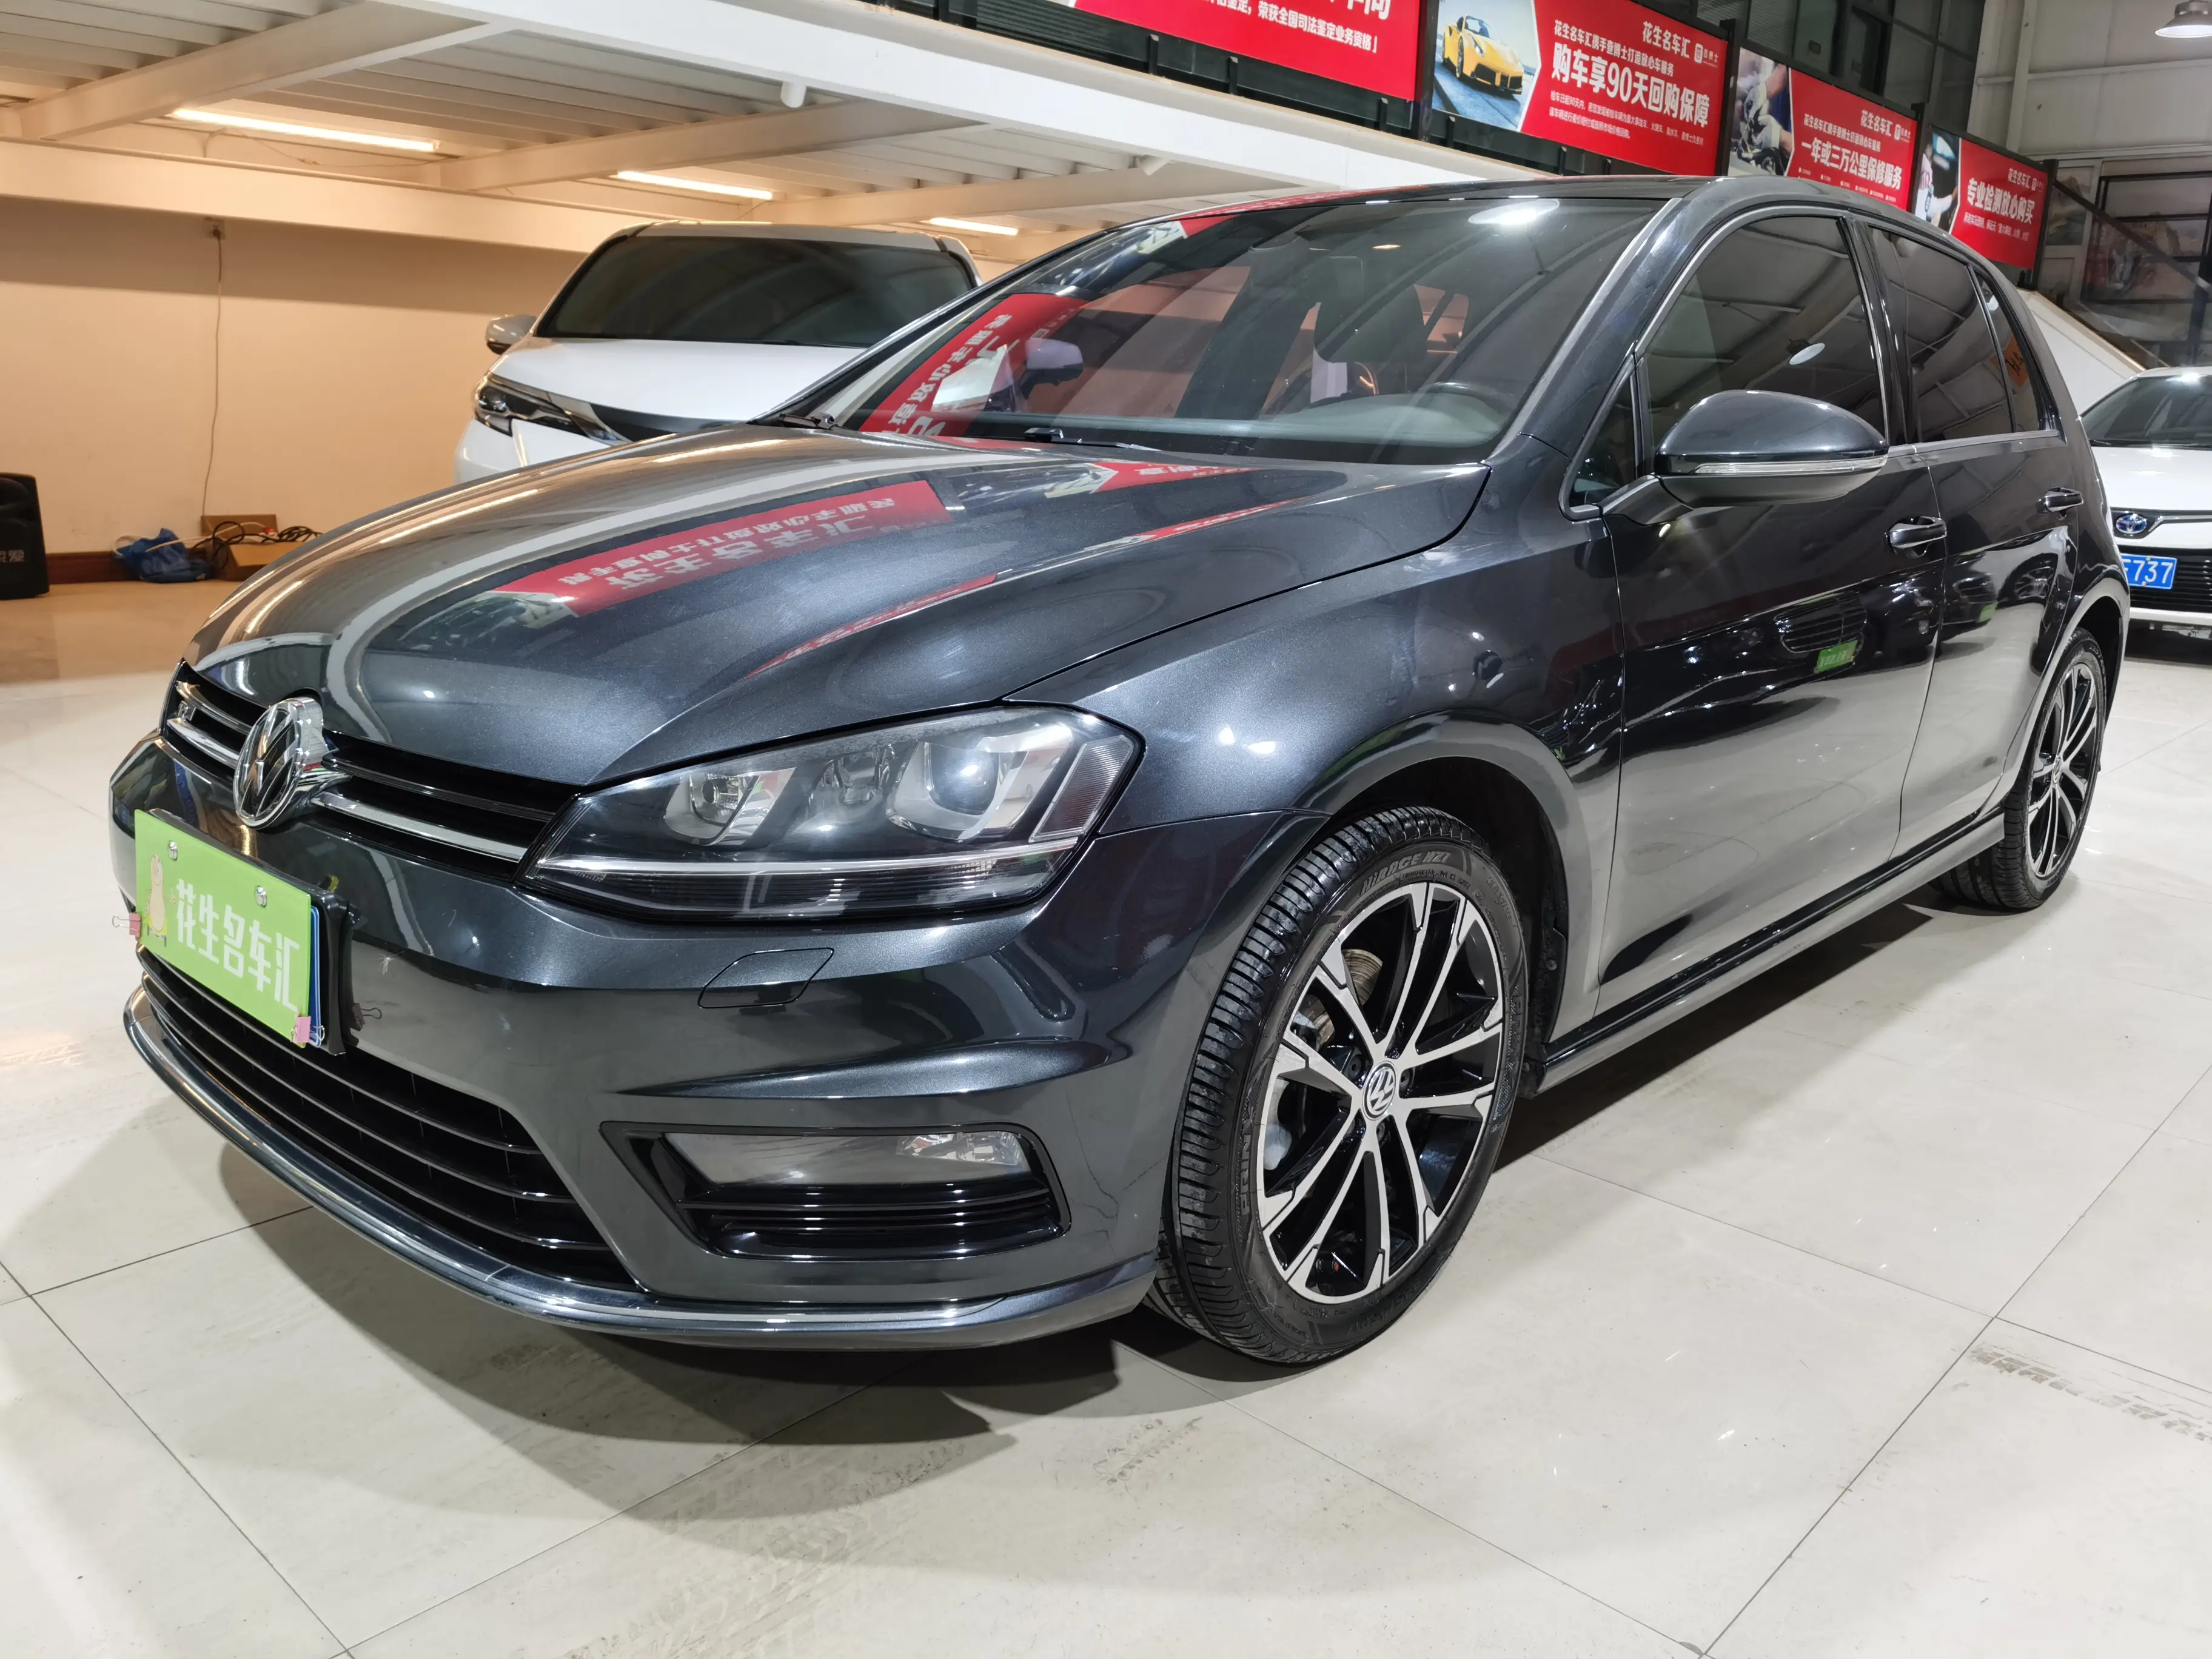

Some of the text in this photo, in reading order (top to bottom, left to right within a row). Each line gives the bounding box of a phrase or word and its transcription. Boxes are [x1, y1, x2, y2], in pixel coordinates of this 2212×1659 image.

[1643, 21, 1691, 59] 花生名车汇
[1551, 42, 1711, 128] 购车享90天回购保障
[1801, 136, 1903, 190] 一年或三万公里保修服务
[176, 877, 300, 1013] 花生名车汇
